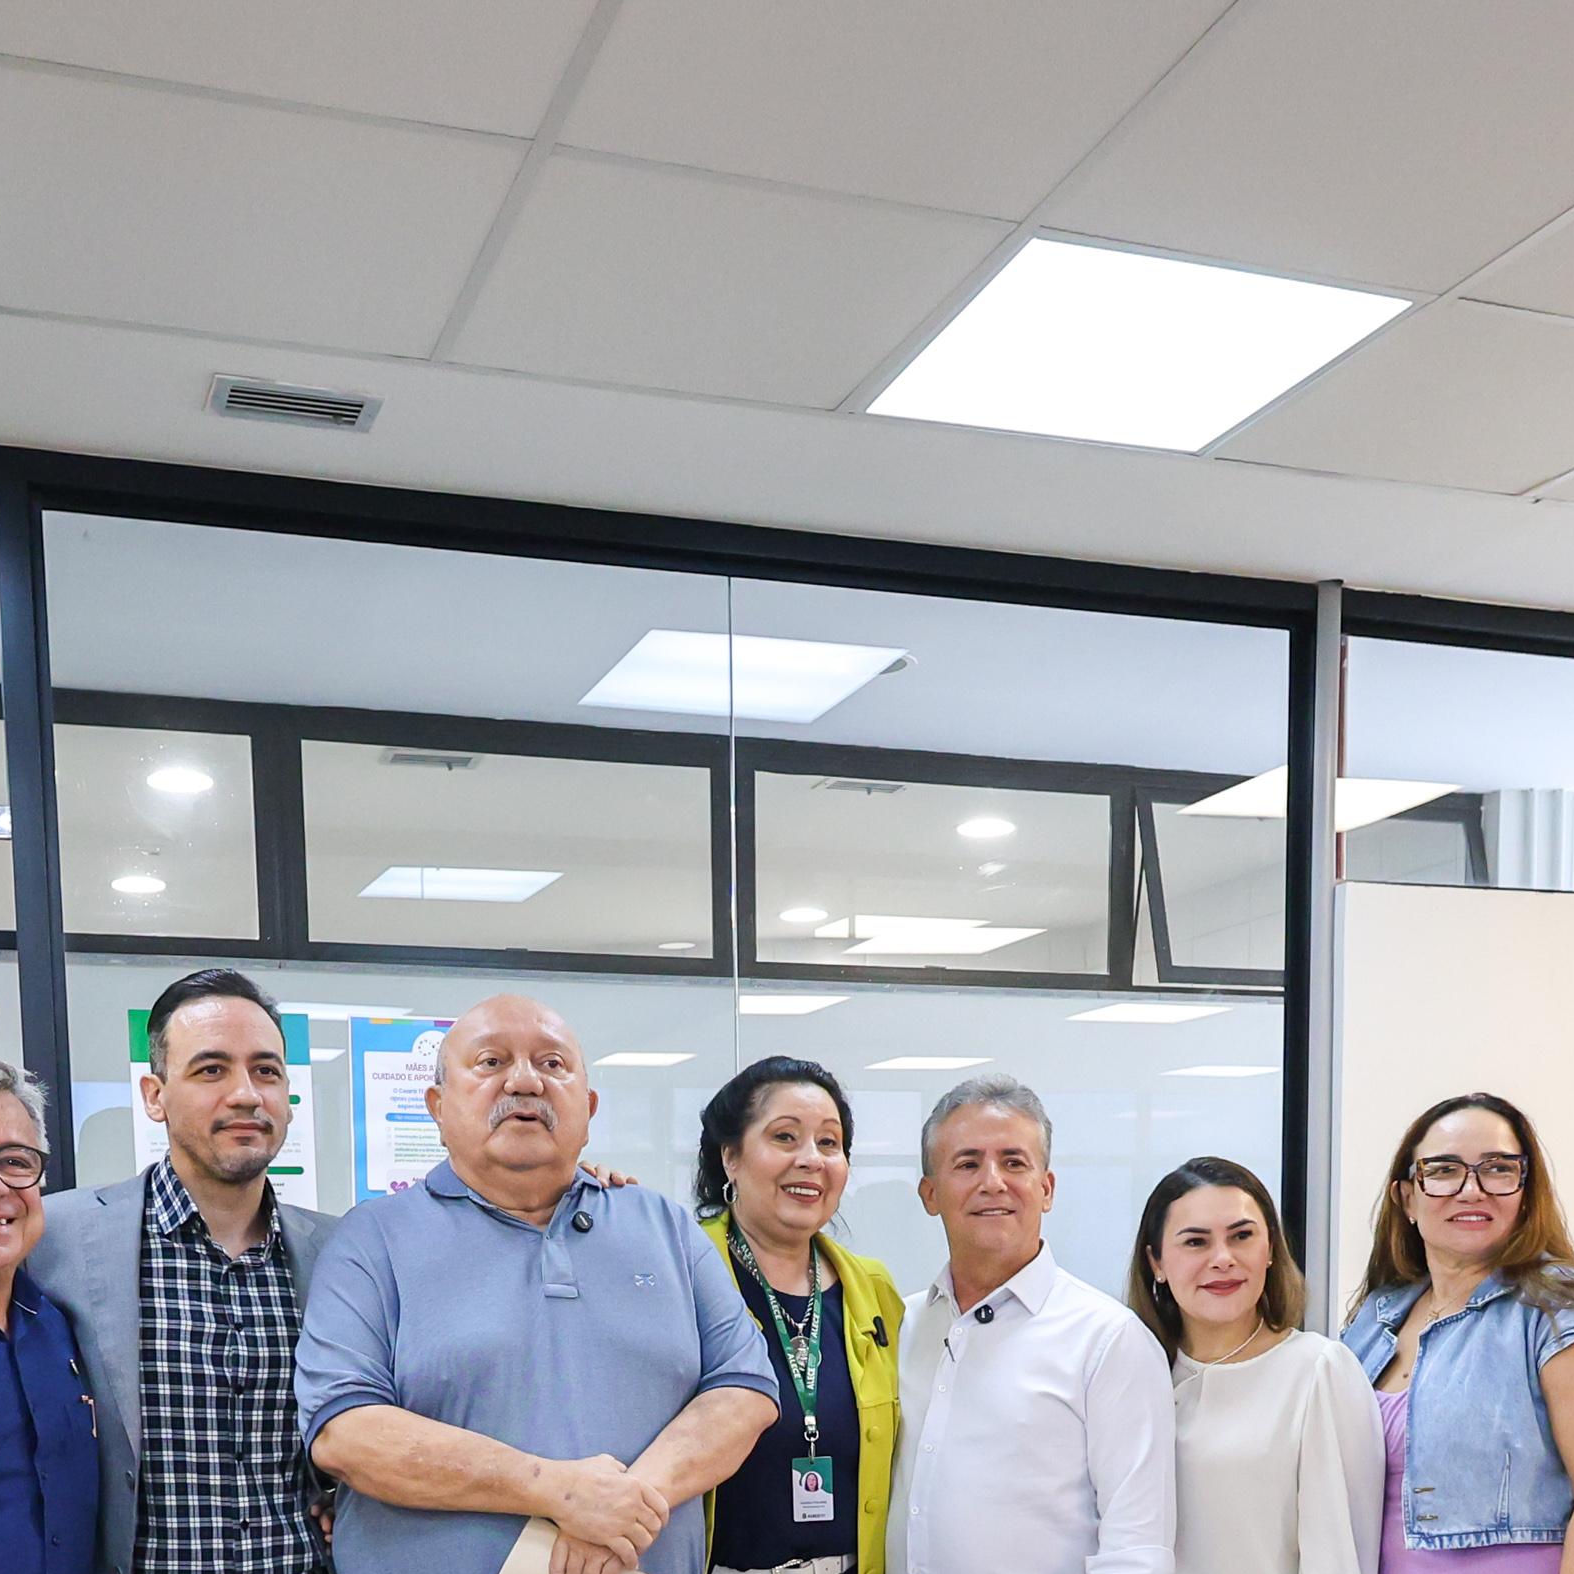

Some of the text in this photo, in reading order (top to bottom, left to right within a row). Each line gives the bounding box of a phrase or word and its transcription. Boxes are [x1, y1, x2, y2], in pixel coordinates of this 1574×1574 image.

[372, 1072, 406, 1081] CUIDADO
[407, 1073, 413, 1081] E
[405, 1062, 428, 1072] MÃES
[398, 1087, 418, 1095] Ceará
[768, 1294, 782, 1320] ALECE
[811, 1313, 820, 1338] ALECE
[787, 1353, 801, 1379] ALECE
[806, 1367, 816, 1390] ALECE
